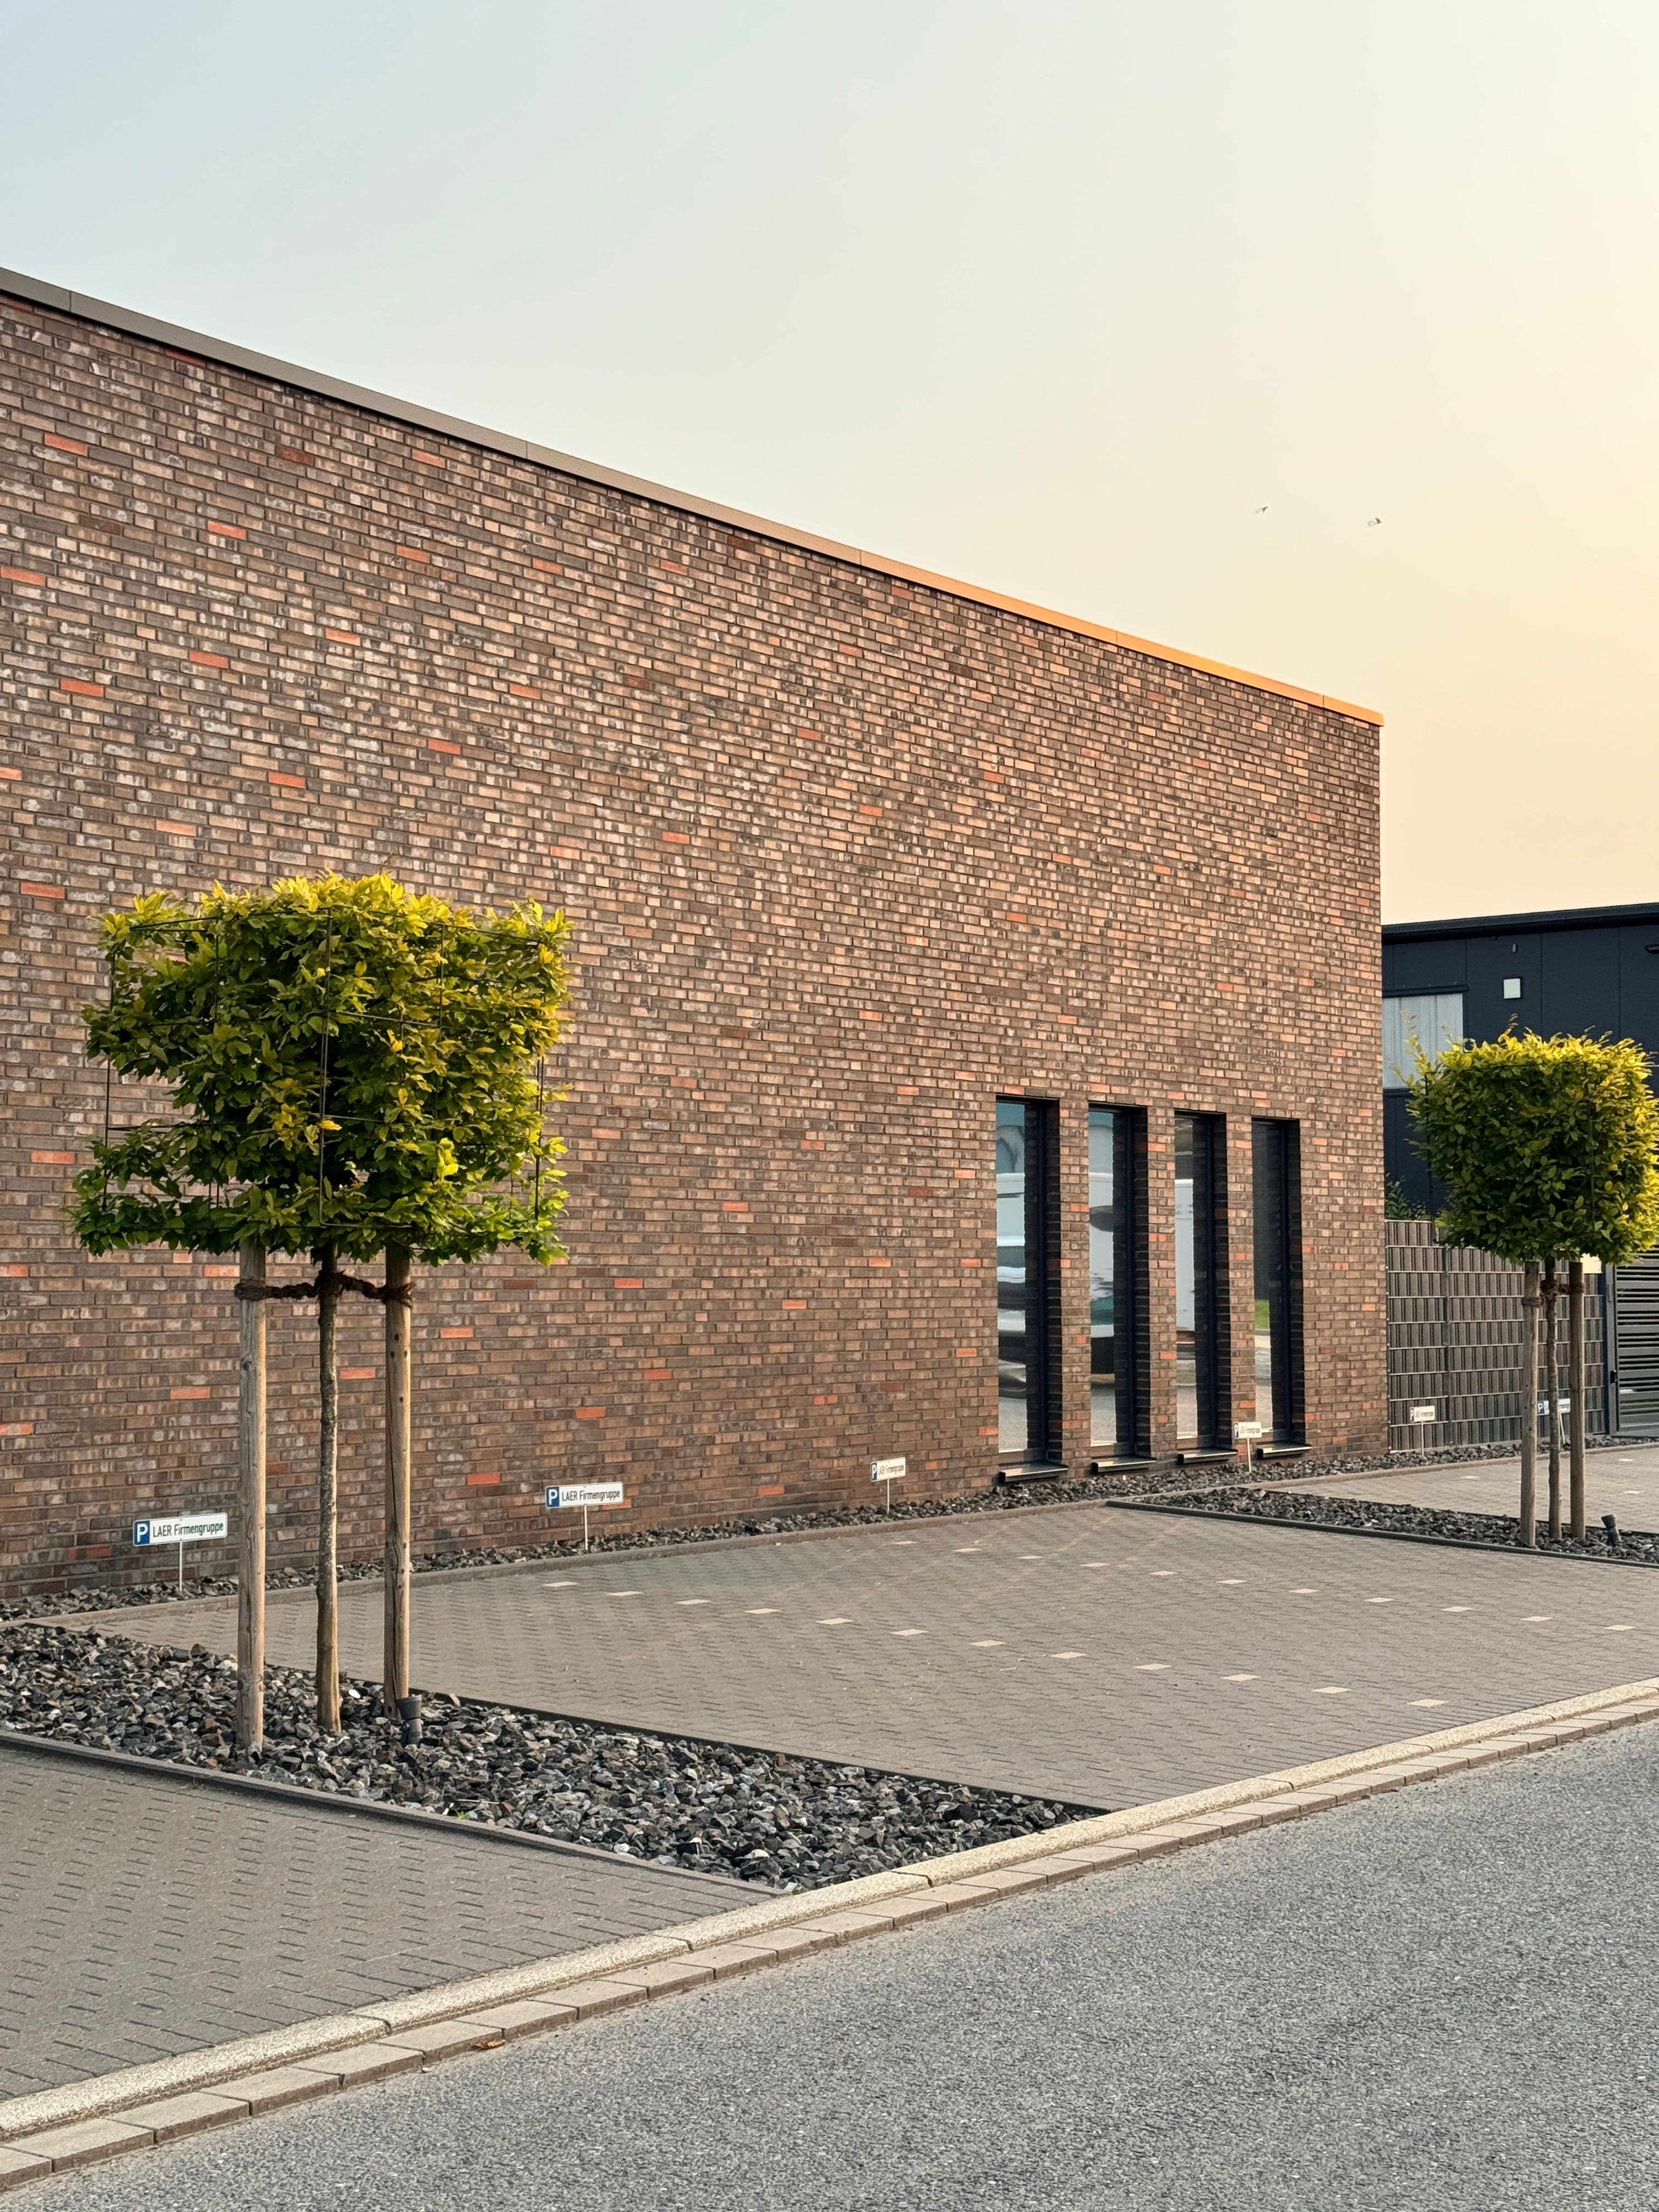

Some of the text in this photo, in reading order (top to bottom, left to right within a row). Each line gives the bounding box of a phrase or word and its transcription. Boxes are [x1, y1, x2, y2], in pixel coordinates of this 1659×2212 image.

[1410, 1409, 1414, 1420] P
[1538, 1403, 1543, 1413] P
[1234, 1424, 1238, 1436] P
[872, 1464, 876, 1480] P
[549, 1489, 620, 1505] P LAER Firmengruppe
[137, 1523, 224, 1543] P LAER Firmengruppe
